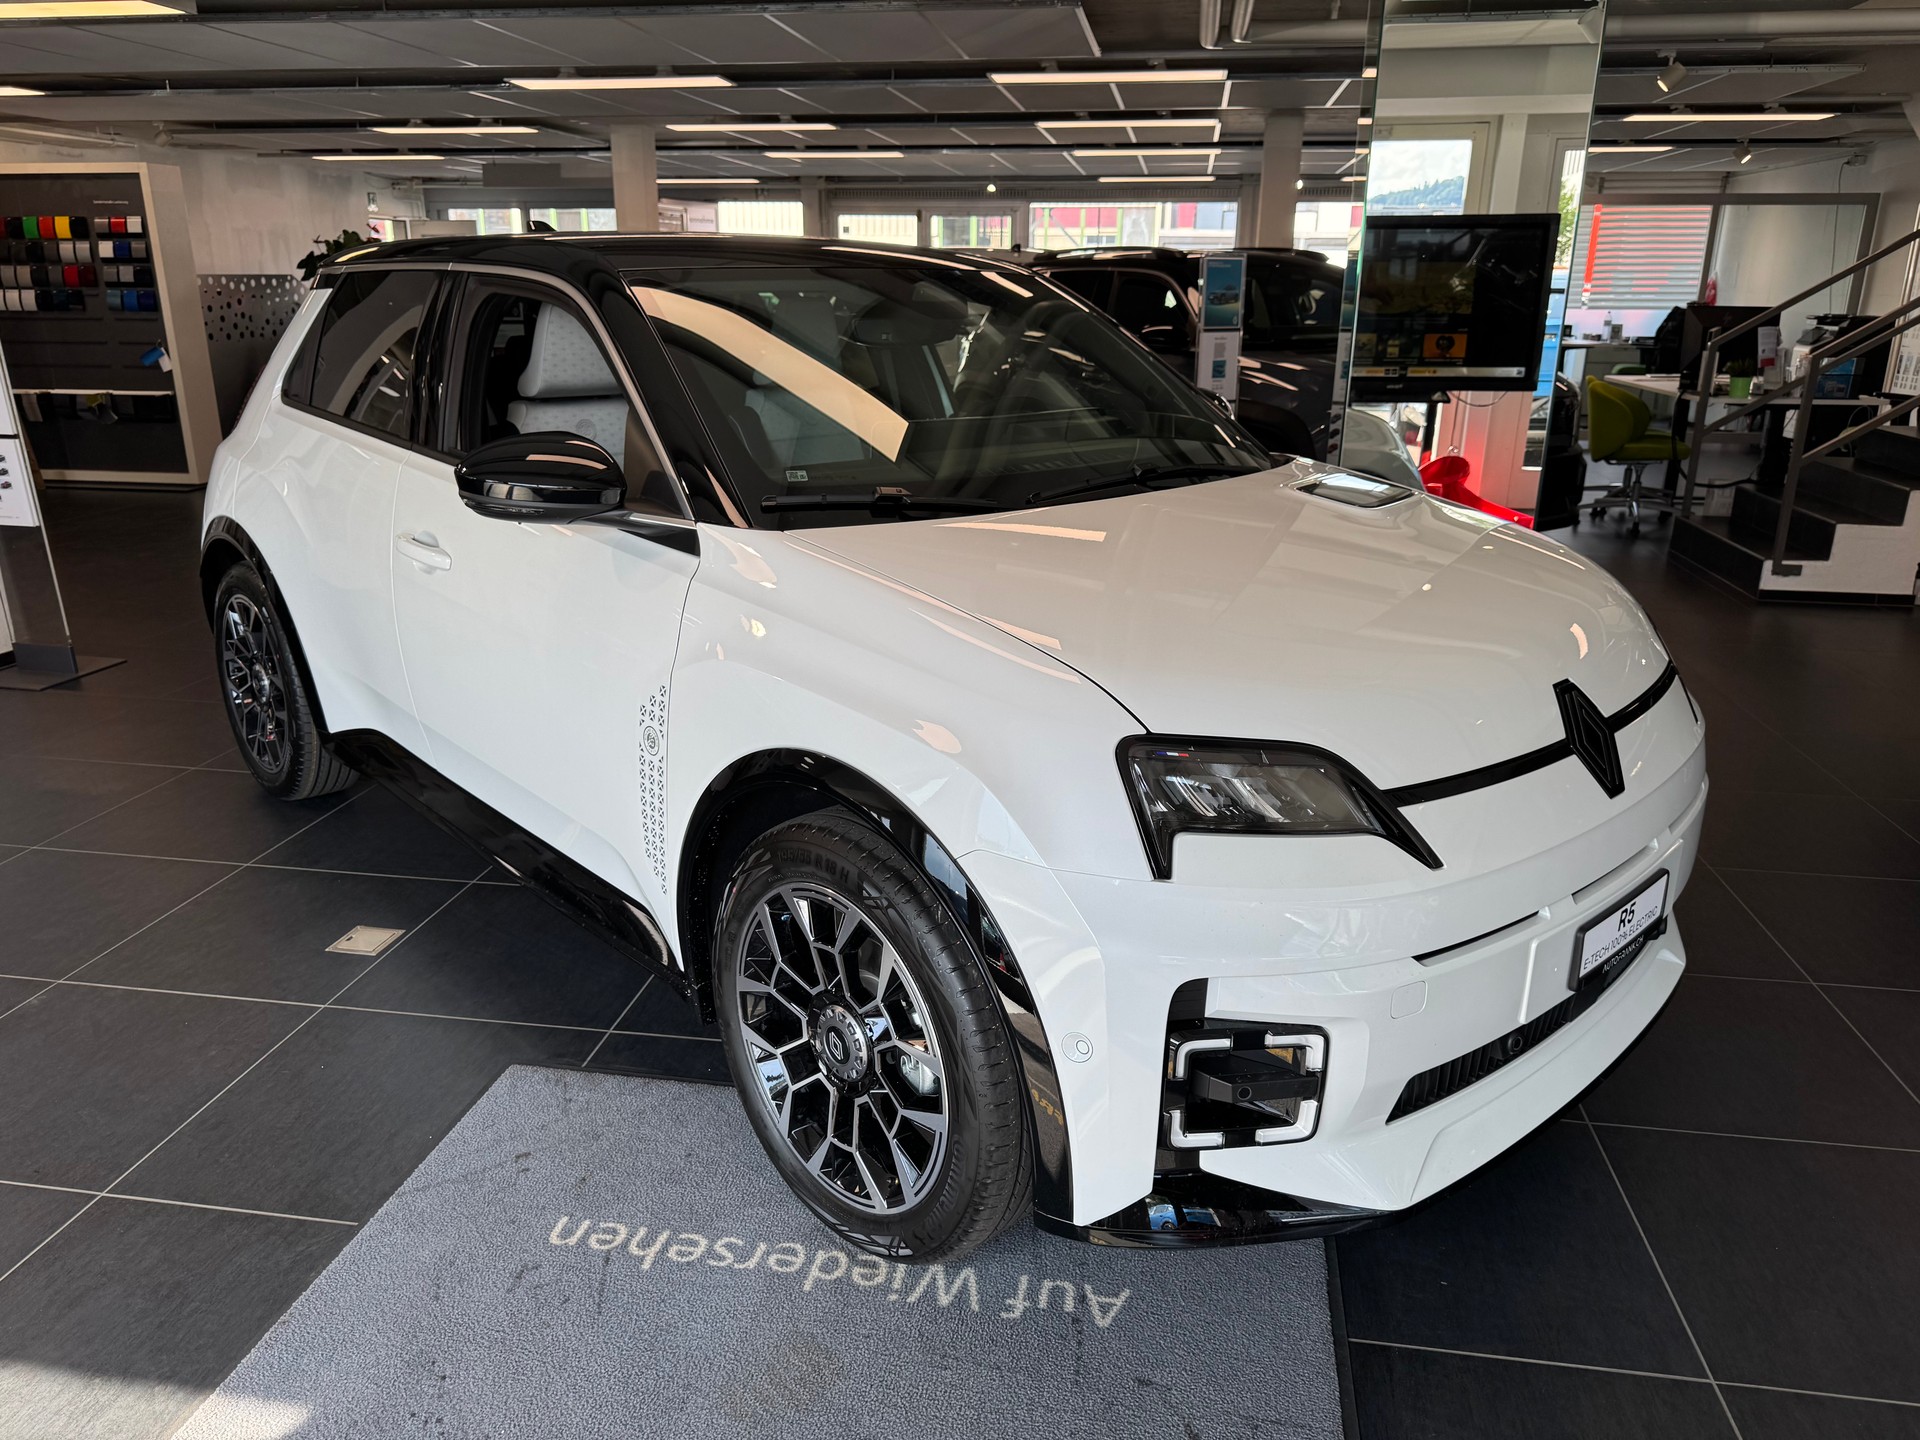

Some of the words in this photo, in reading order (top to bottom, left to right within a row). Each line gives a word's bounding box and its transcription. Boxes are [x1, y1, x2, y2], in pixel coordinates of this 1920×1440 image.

[1583, 943, 1610, 970] E-TECH
[1609, 931, 1628, 951] 100%
[1628, 905, 1658, 937] ELECTRIC
[1617, 901, 1637, 932] R5
[547, 1214, 980, 1312] Wiedersehen
[999, 1274, 1131, 1328] Auf
